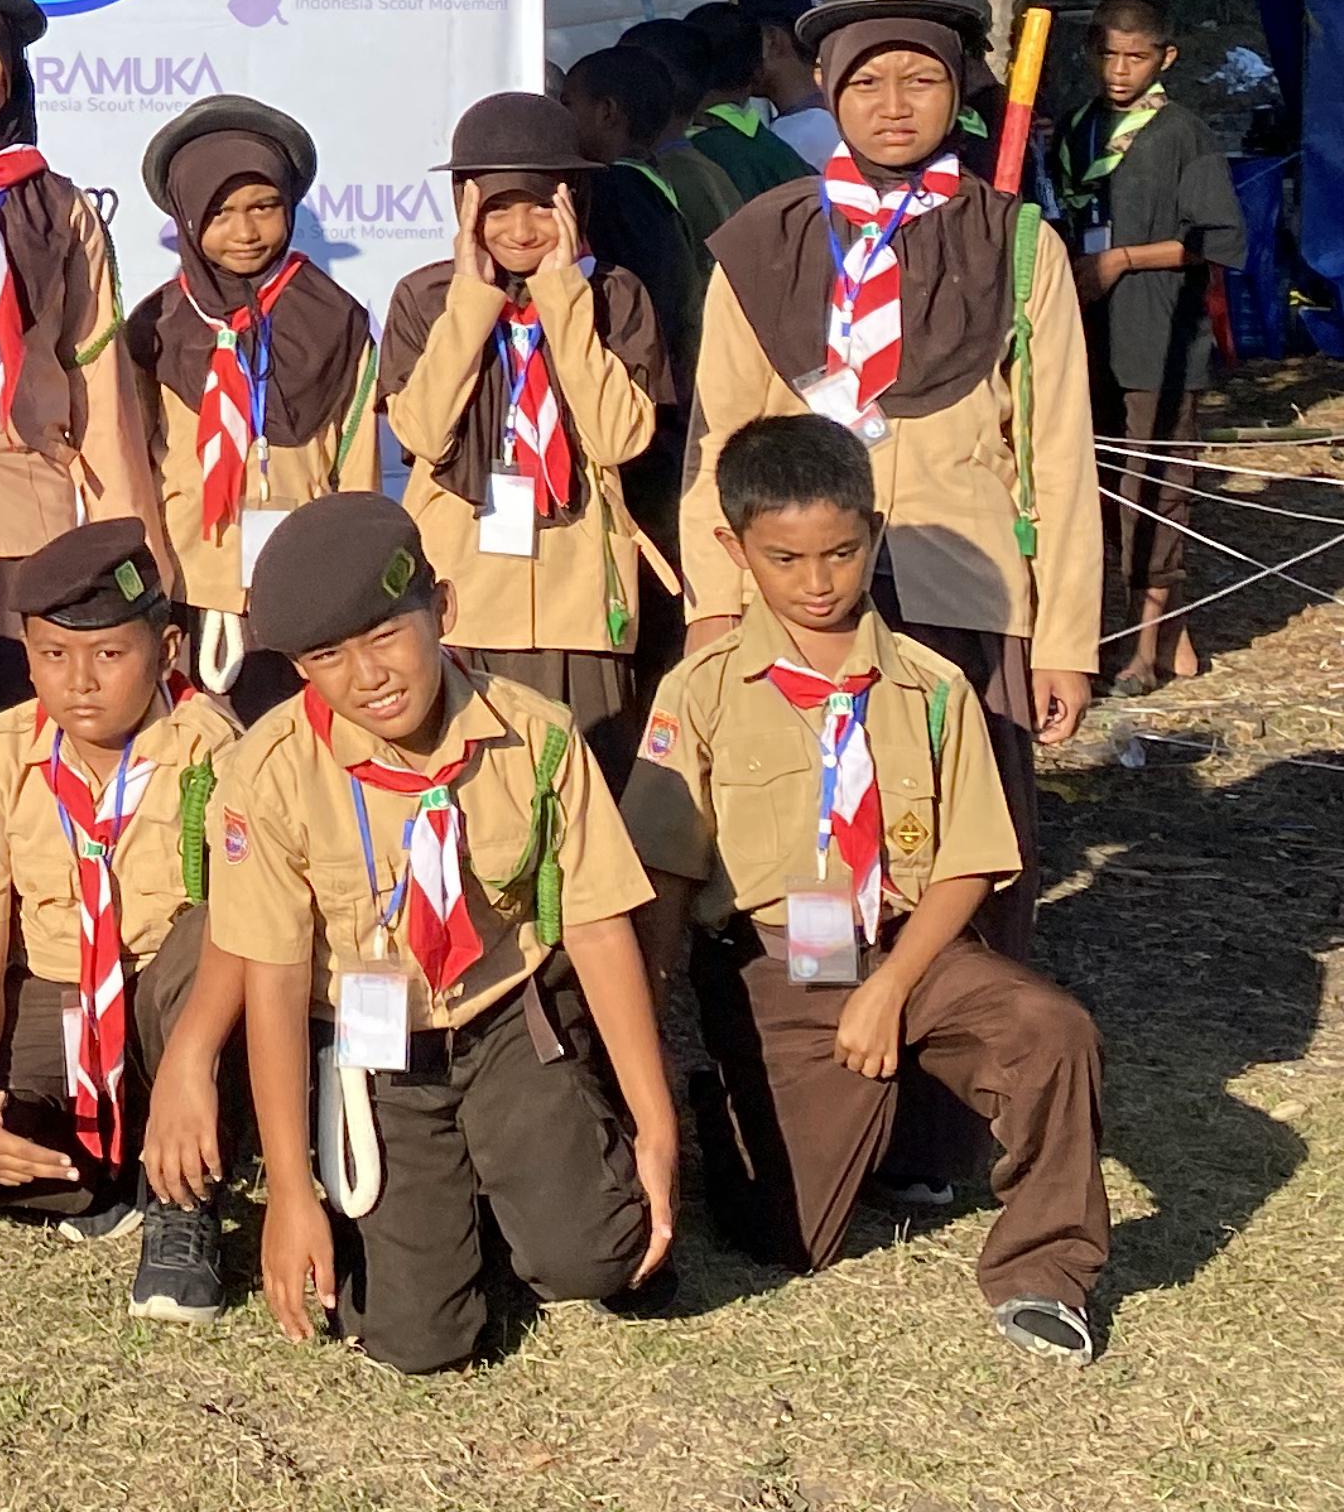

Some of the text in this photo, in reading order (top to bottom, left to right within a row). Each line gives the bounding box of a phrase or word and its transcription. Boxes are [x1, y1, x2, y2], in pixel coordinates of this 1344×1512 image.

[35, 50, 223, 95] RAMUKA
[38, 99, 81, 113] nesia
[87, 98, 135, 113] Scout
[305, 179, 444, 222] MUKA
[362, 226, 445, 240] Movement
